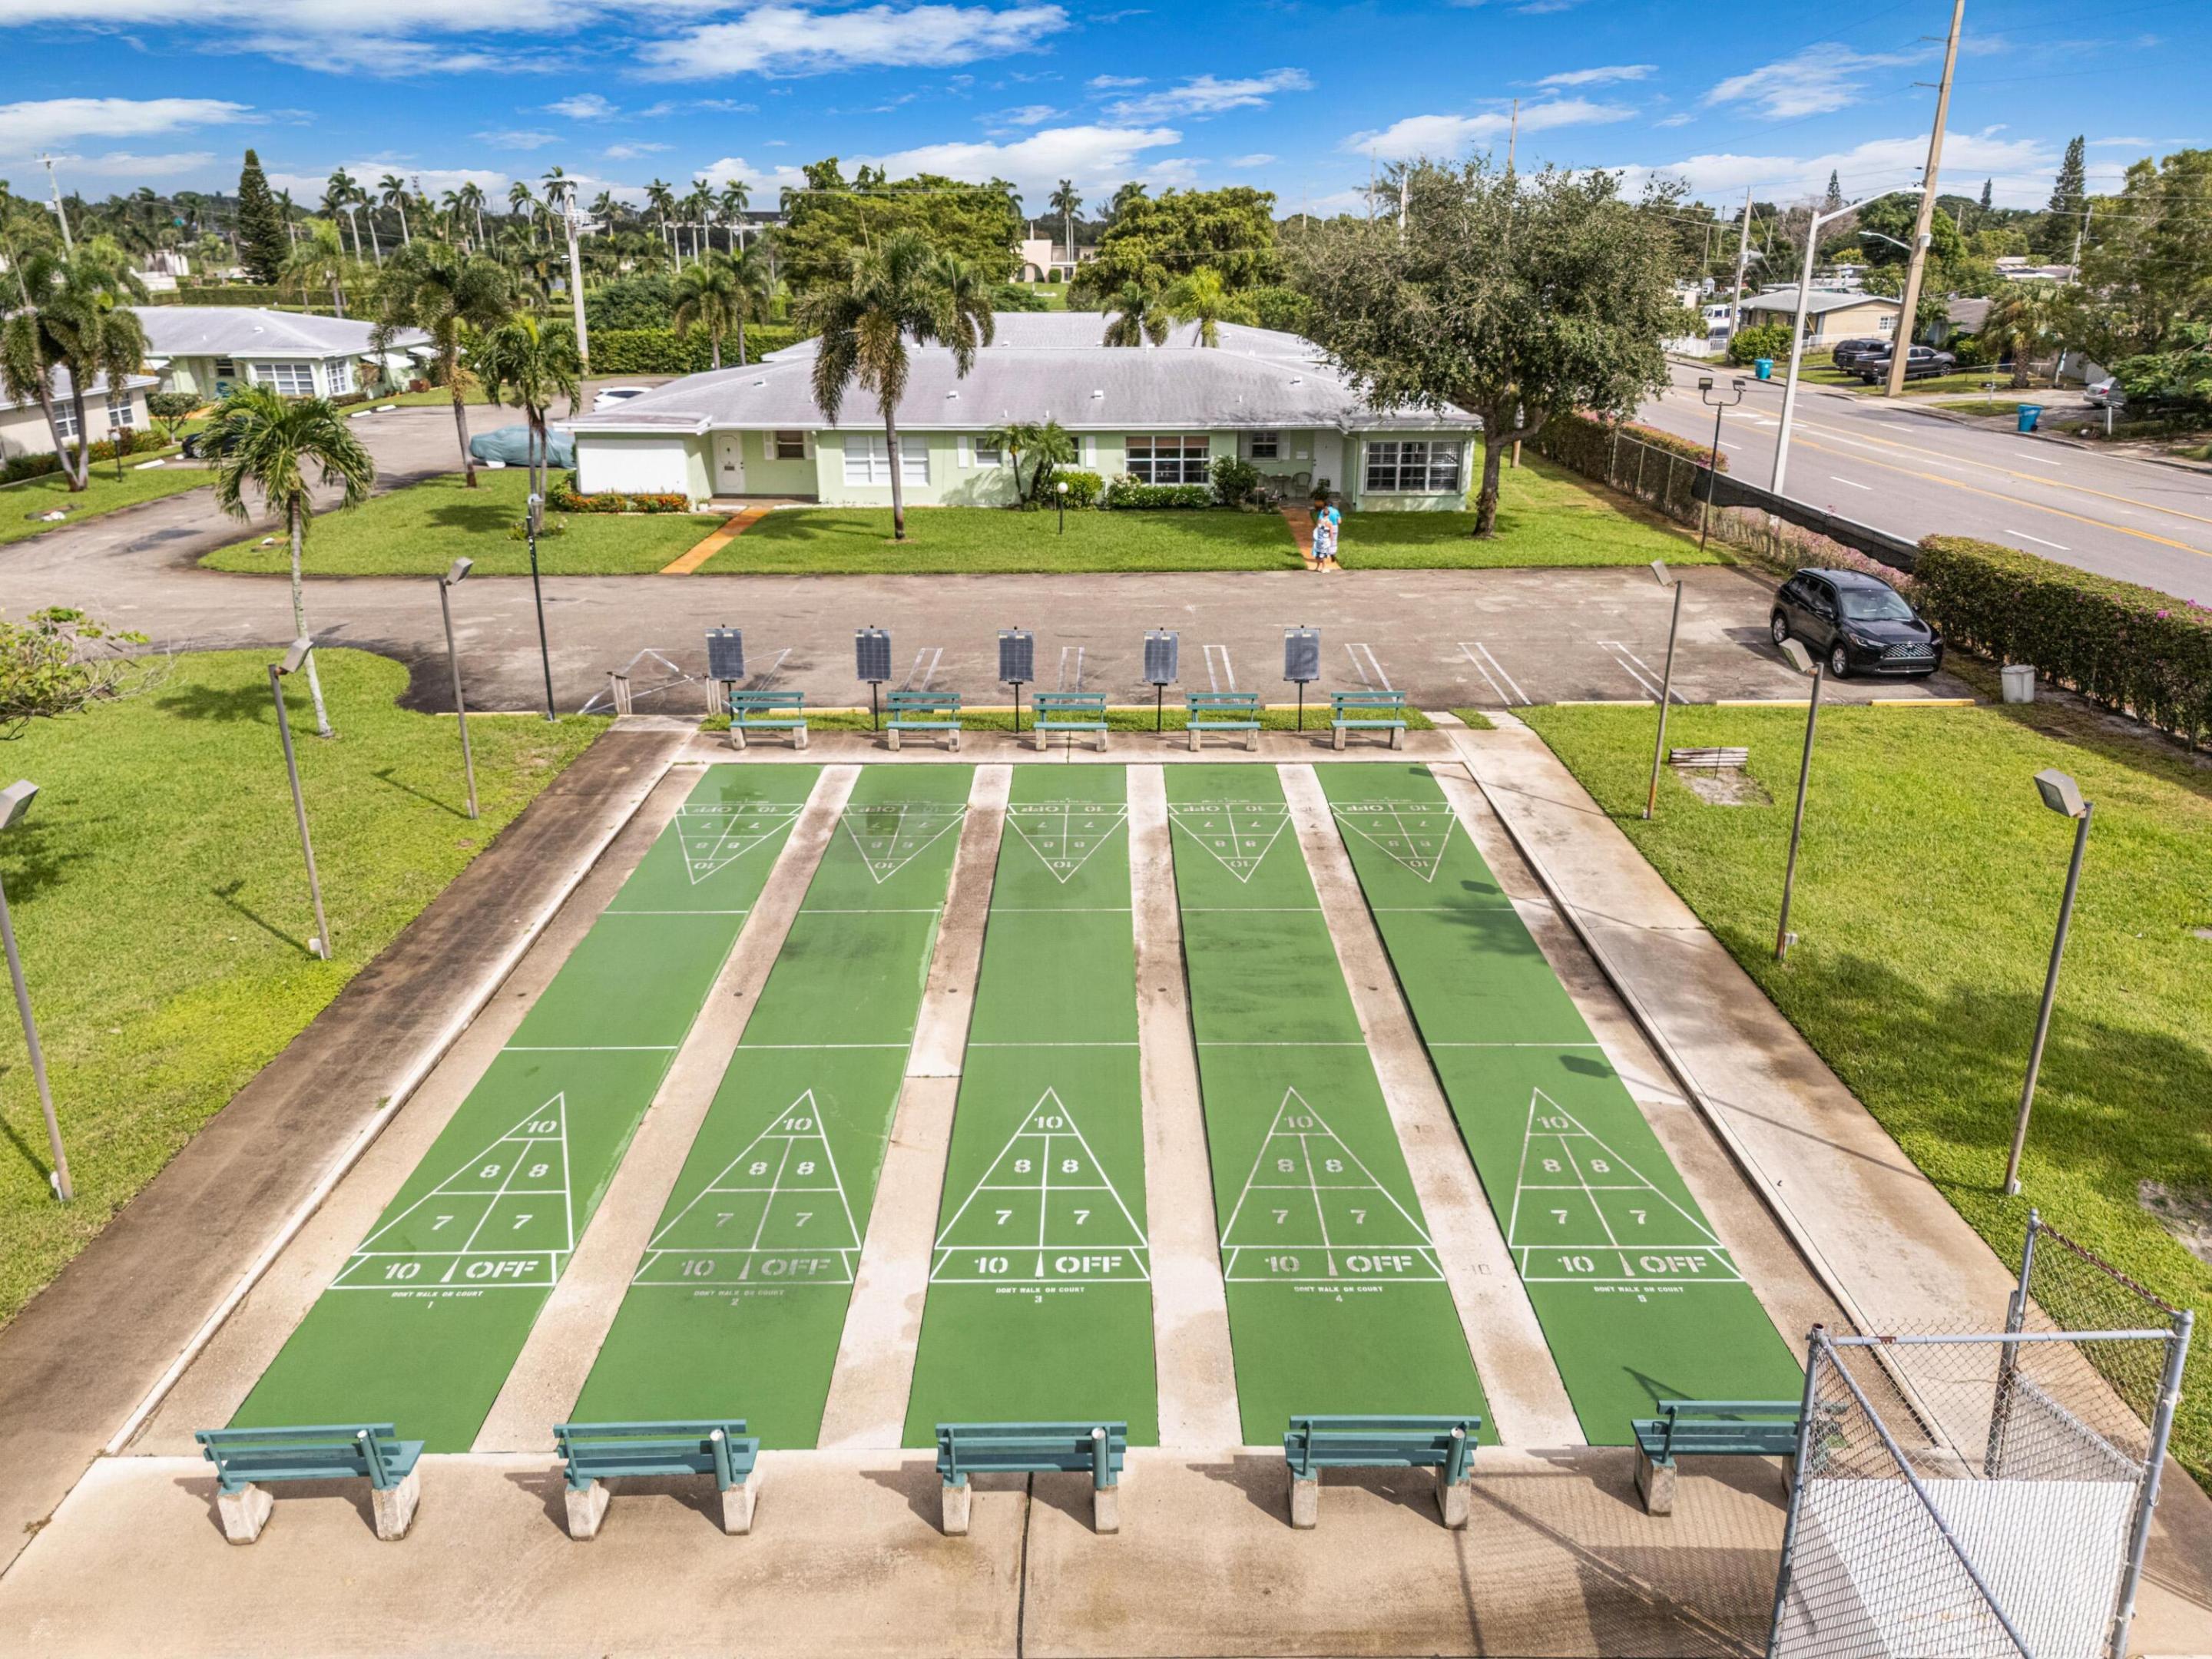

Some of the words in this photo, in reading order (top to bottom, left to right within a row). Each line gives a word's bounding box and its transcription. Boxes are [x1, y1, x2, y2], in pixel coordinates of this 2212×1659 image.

[527, 1120, 557, 1133] 10
[783, 1118, 812, 1130] 10
[1034, 1116, 1064, 1128] 10
[1284, 1116, 1313, 1128] 10
[1537, 1116, 1568, 1128] 10
[480, 1165, 500, 1177] 8
[528, 1164, 548, 1177] 8
[750, 1162, 767, 1175] 8
[797, 1162, 815, 1174] 8
[1015, 1160, 1031, 1173] 8
[1062, 1160, 1078, 1173] 8
[1278, 1159, 1294, 1172] 8
[1326, 1160, 1343, 1172] 8
[1542, 1159, 1561, 1172] 8
[1591, 1160, 1610, 1172] 8
[432, 1216, 453, 1230] 7
[513, 1214, 532, 1229] 7
[717, 1213, 733, 1227] 7
[796, 1213, 813, 1227] 7
[996, 1210, 1012, 1224] 7
[1074, 1210, 1090, 1224] 7
[1272, 1210, 1288, 1224] 7
[1350, 1210, 1366, 1224] 7
[1551, 1210, 1567, 1224] 7
[1630, 1210, 1646, 1224] 7
[386, 1263, 420, 1279] 10
[466, 1261, 538, 1278] OFF
[682, 1260, 714, 1276] 10
[762, 1259, 831, 1275] OFF
[975, 1257, 1008, 1273] 10
[1055, 1257, 1121, 1273] OFF
[1265, 1257, 1299, 1272] 10
[1346, 1256, 1412, 1272] OFF
[1558, 1257, 1594, 1272] 10
[1640, 1257, 1707, 1273] OFF
